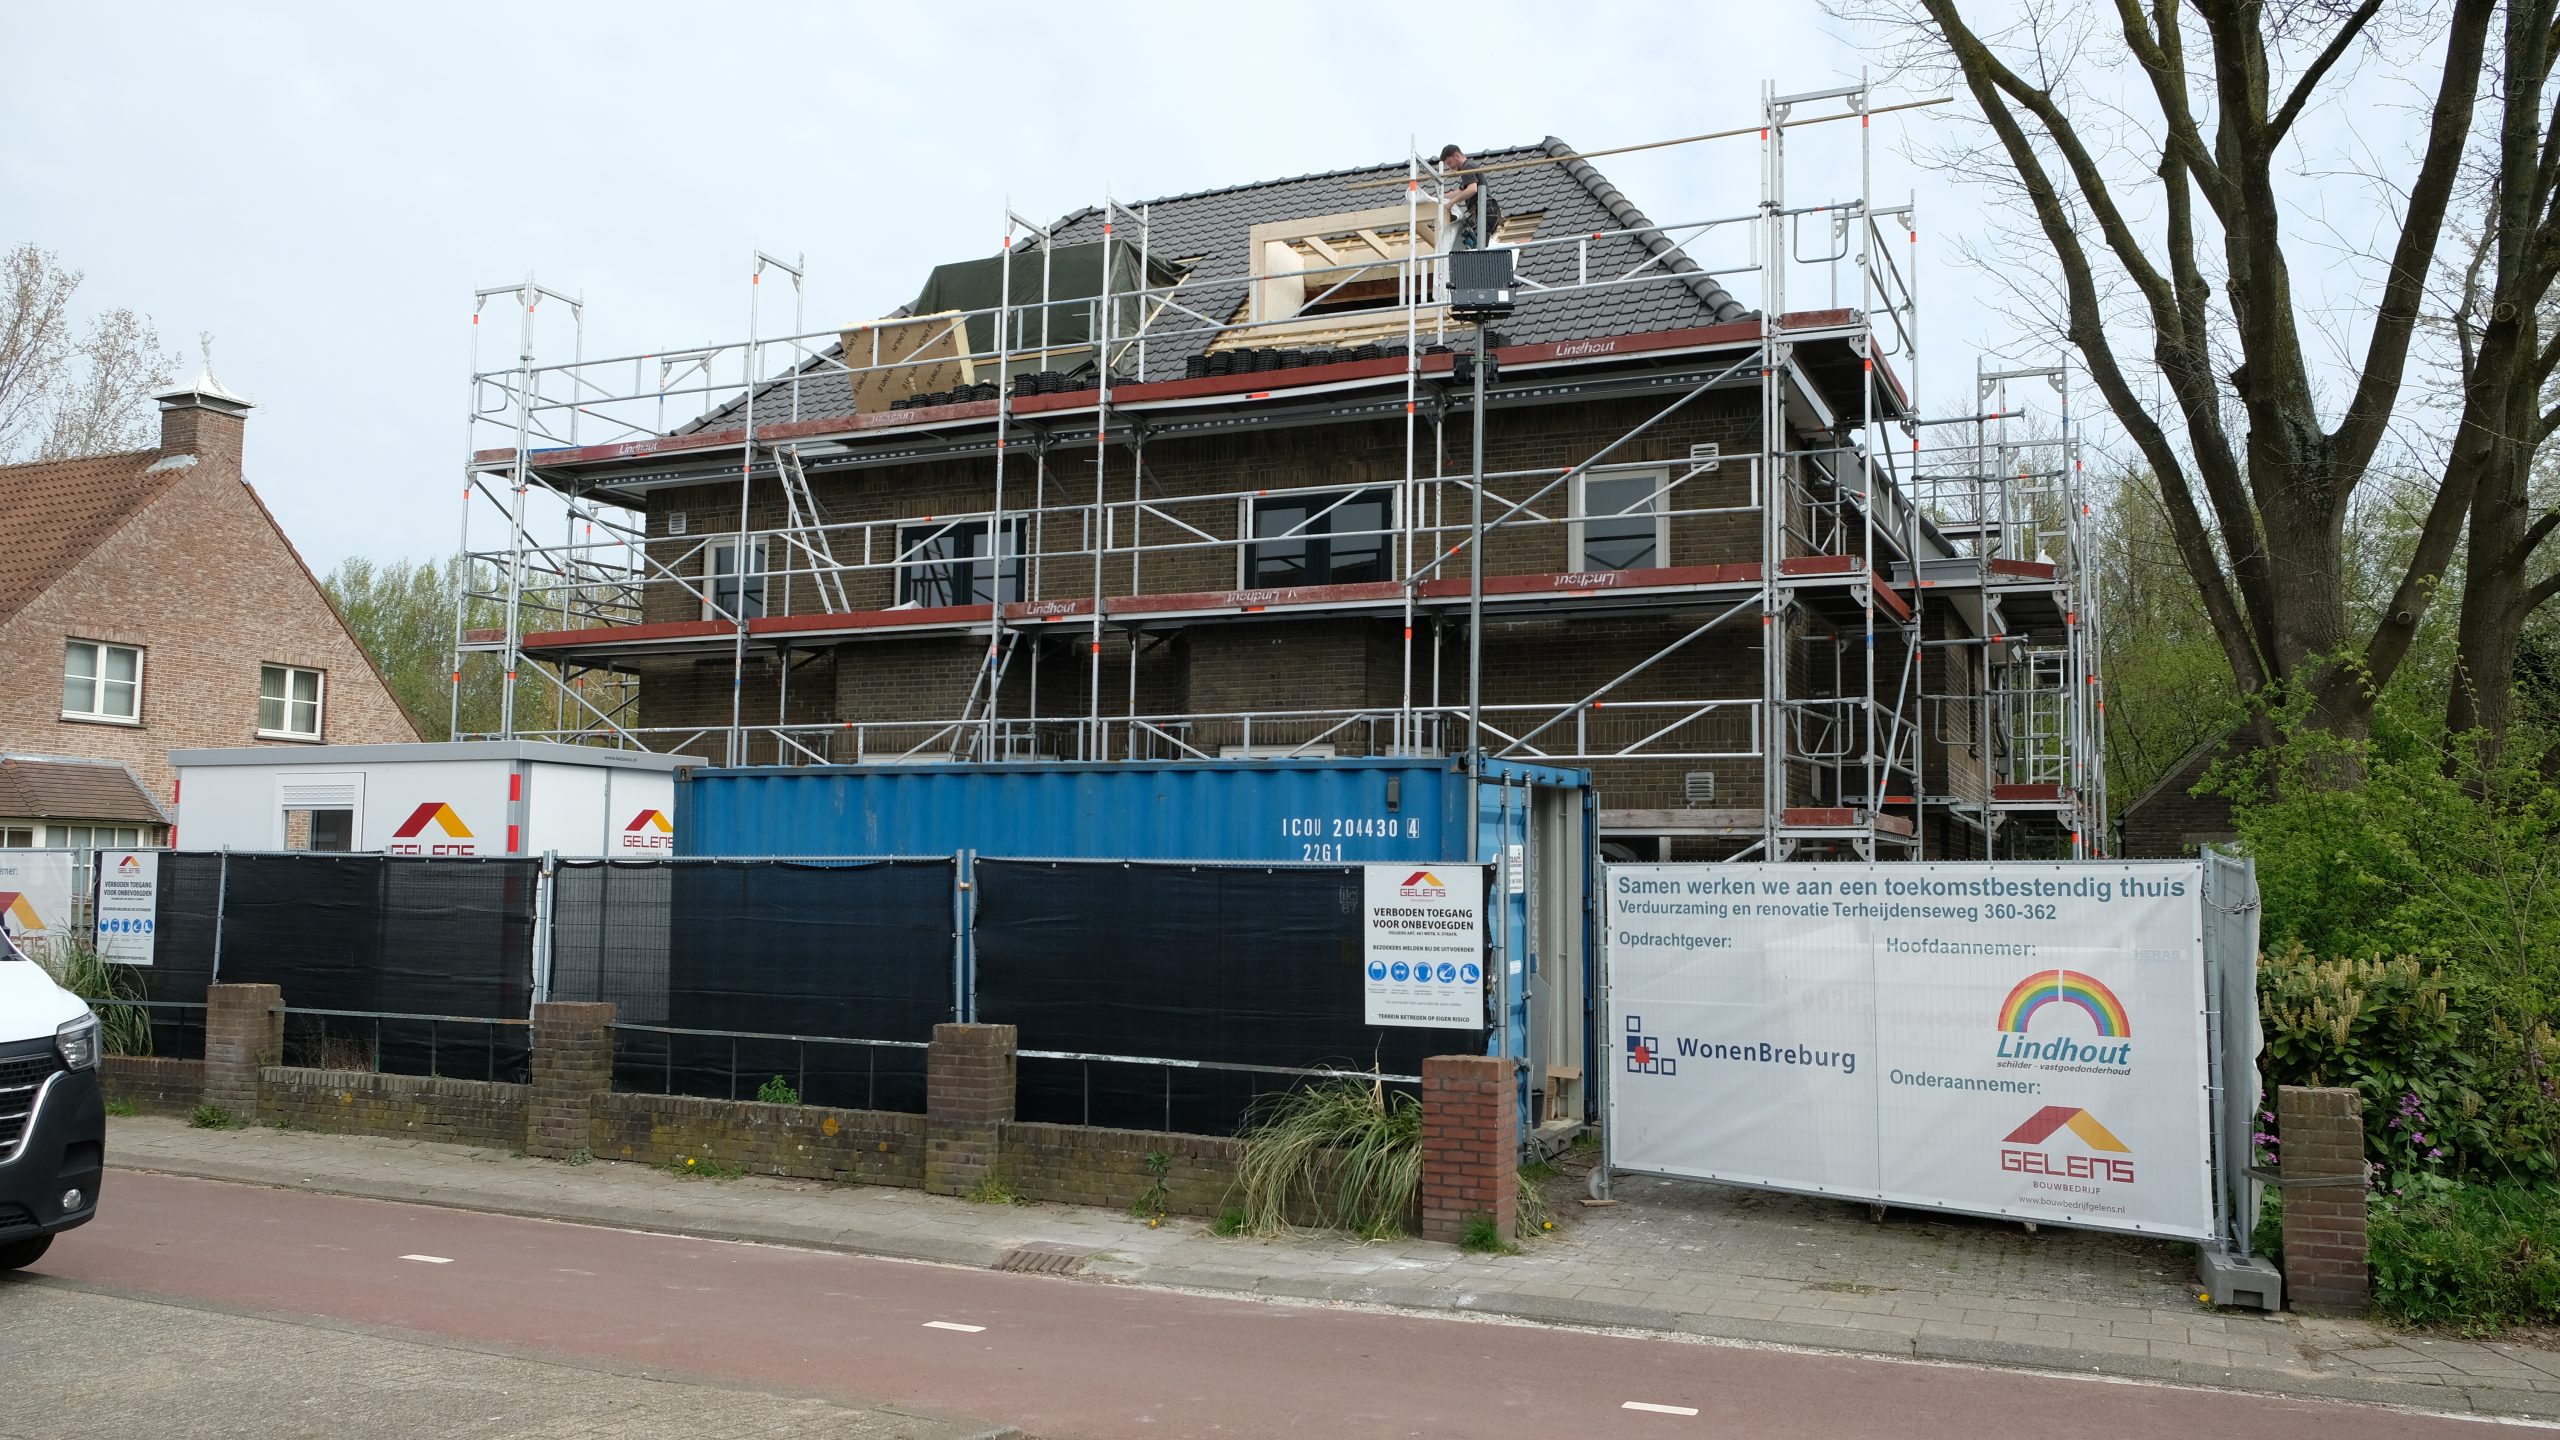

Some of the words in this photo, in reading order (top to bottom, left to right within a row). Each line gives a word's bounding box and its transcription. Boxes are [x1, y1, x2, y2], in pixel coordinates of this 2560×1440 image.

[1556, 341, 1616, 356] Lindhout
[1554, 573, 1616, 587] Lindhout
[1226, 591, 1280, 604] Lindhout
[1026, 602, 1076, 615] Lindhout
[1282, 818, 1321, 837] ICOU
[1333, 819, 1398, 837] 204430
[1408, 818, 1418, 837] 4
[1303, 844, 1342, 861] 22G1
[1400, 888, 1446, 898] GELENS
[1618, 876, 1681, 895] Samen
[1687, 877, 1755, 895] werken
[1762, 880, 1790, 895] we
[1796, 880, 1833, 896] aan
[1839, 880, 1879, 896] een
[1884, 876, 2112, 903] toekomstbestendig
[2120, 877, 2186, 898] thuis
[1374, 907, 1425, 917] VERBODEN
[1427, 908, 1473, 918] TOEGANG
[1618, 900, 1728, 919] Verduurzaming
[1732, 904, 1751, 916] en
[1756, 901, 1829, 917] renovatie
[1832, 902, 1978, 923] Terheijdenseweg
[1984, 903, 2057, 921] 360-362
[1373, 919, 1400, 929] VOOR
[1401, 920, 1474, 930] ONBEVOEGDEN
[1619, 931, 1732, 949] Opdrachtgever:
[1886, 937, 2037, 957] Hoofdaannemer:
[1676, 1036, 1856, 1074] WonenBreburg
[1996, 1033, 2132, 1066] Lindhout
[1996, 1060, 2033, 1070] schilder
[2039, 1062, 2132, 1077] vastgoedonderhoud
[1889, 1068, 2041, 1096] Onderaannemer:
[2001, 1149, 2135, 1184] GELENS
[2032, 1180, 2102, 1195] BOUWBEDRIJF
[2018, 1195, 2126, 1214] www.bouwbedrijfgelens.nl
